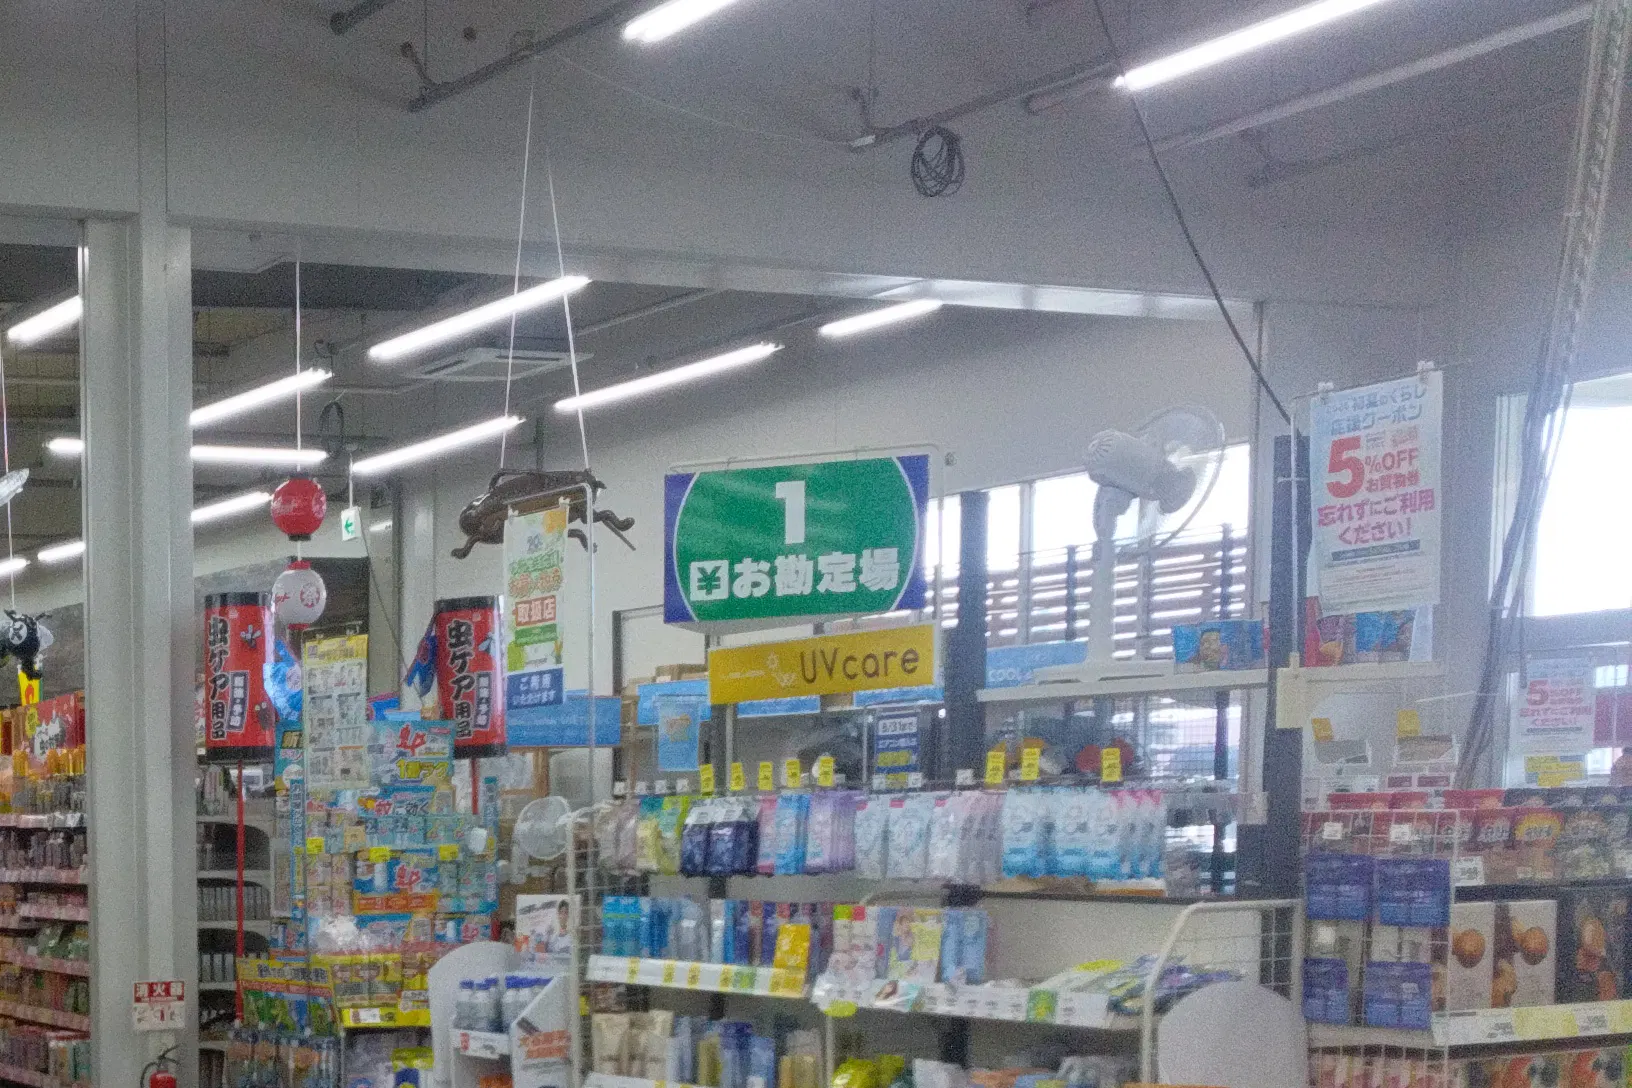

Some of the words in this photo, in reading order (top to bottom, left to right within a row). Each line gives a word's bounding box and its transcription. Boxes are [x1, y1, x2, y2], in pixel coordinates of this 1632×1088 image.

[1327, 436, 1365, 498] 5
[1365, 447, 1418, 473] %OFF
[775, 481, 806, 544] 1
[1318, 489, 1435, 527] 忘れずにご利用
[733, 548, 899, 599] お勘定場
[517, 598, 556, 624] 取扱店
[208, 616, 230, 740] 虫ケア用品
[447, 619, 475, 739] 虫ケア用品
